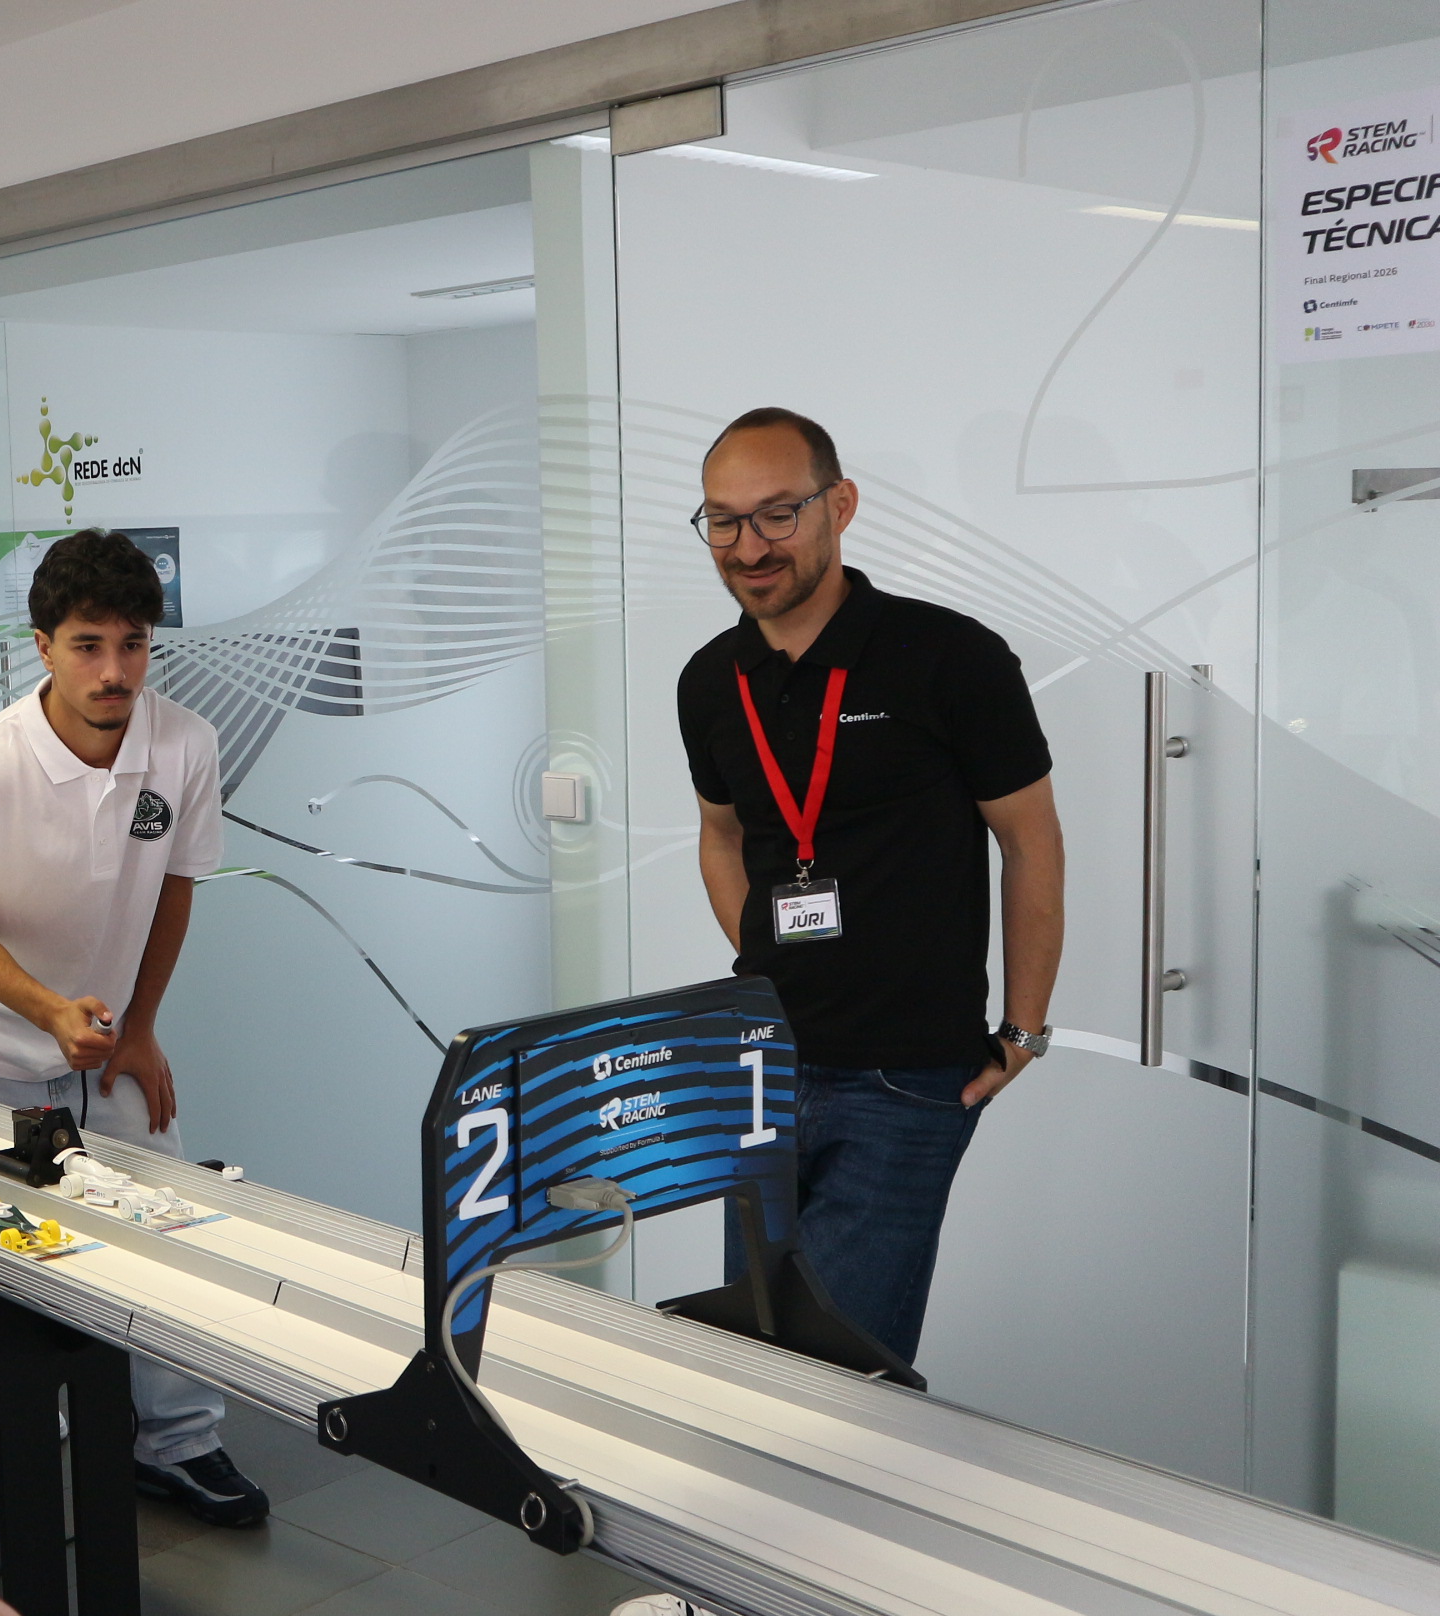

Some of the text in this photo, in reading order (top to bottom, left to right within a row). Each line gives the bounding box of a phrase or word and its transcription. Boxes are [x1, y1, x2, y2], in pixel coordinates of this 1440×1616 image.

[1346, 119, 1408, 142] STEM
[1342, 132, 1418, 158] RACING
[1304, 266, 1398, 285] Final Regional 2026
[1320, 298, 1358, 309] Centimfe
[74, 456, 142, 481] REDE dcN
[133, 821, 163, 831] AVIS
[788, 910, 825, 930] JÚRI
[740, 1025, 775, 1044] LANE
[615, 1046, 673, 1071] Centimfe
[461, 1083, 503, 1105] LANE
[623, 1091, 661, 1111] STEM
[740, 1049, 777, 1149] 1
[621, 1103, 667, 1125] RACING
[599, 1143, 629, 1157] Supported
[629, 1142, 637, 1150] by
[637, 1135, 661, 1147] Formula
[457, 1107, 509, 1221] 2
